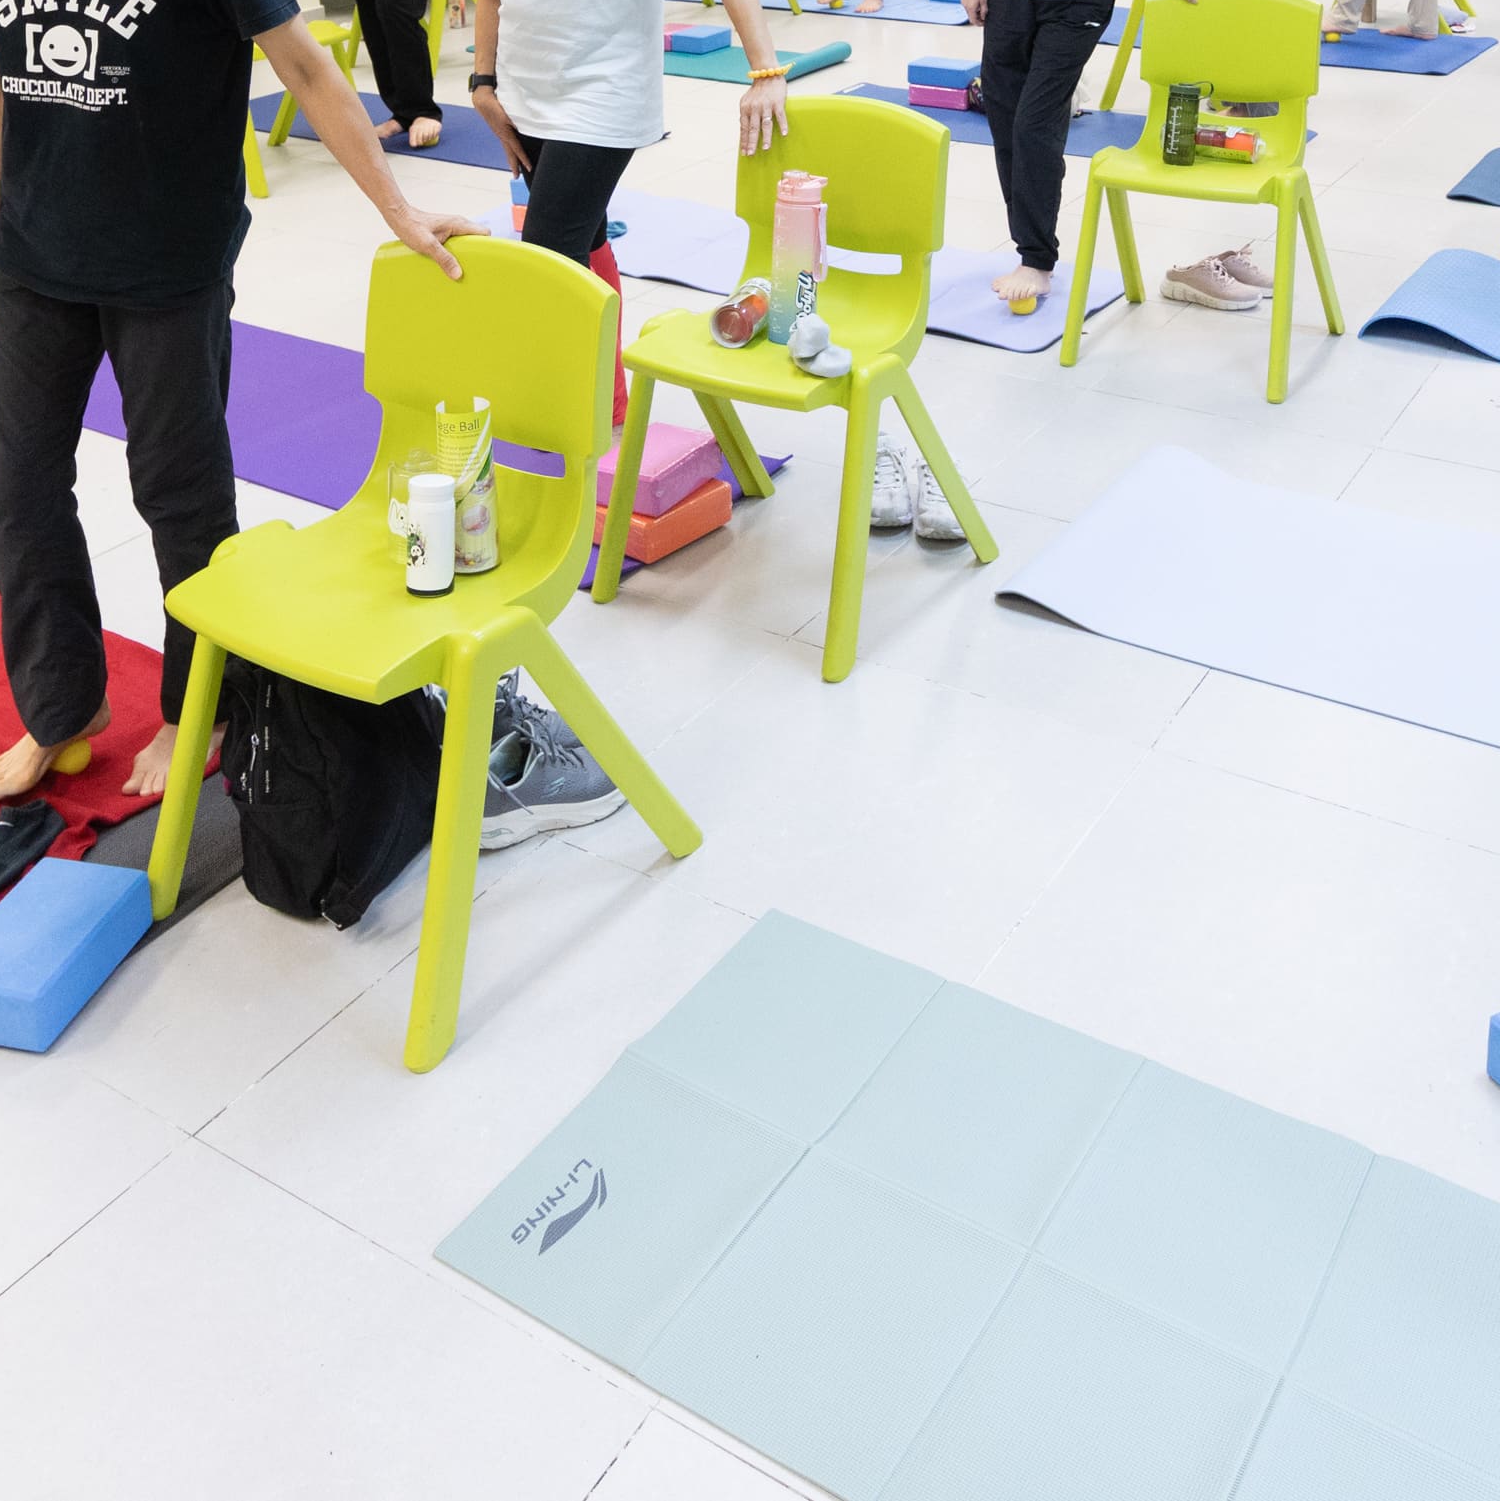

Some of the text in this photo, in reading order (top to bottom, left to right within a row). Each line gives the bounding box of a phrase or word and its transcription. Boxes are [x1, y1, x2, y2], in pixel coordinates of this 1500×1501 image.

[1, 75, 85, 103] CHOCOOLATE
[86, 87, 128, 105] DEPT.
[459, 419, 480, 432] Ball
[510, 1158, 593, 1245] LI-NING
